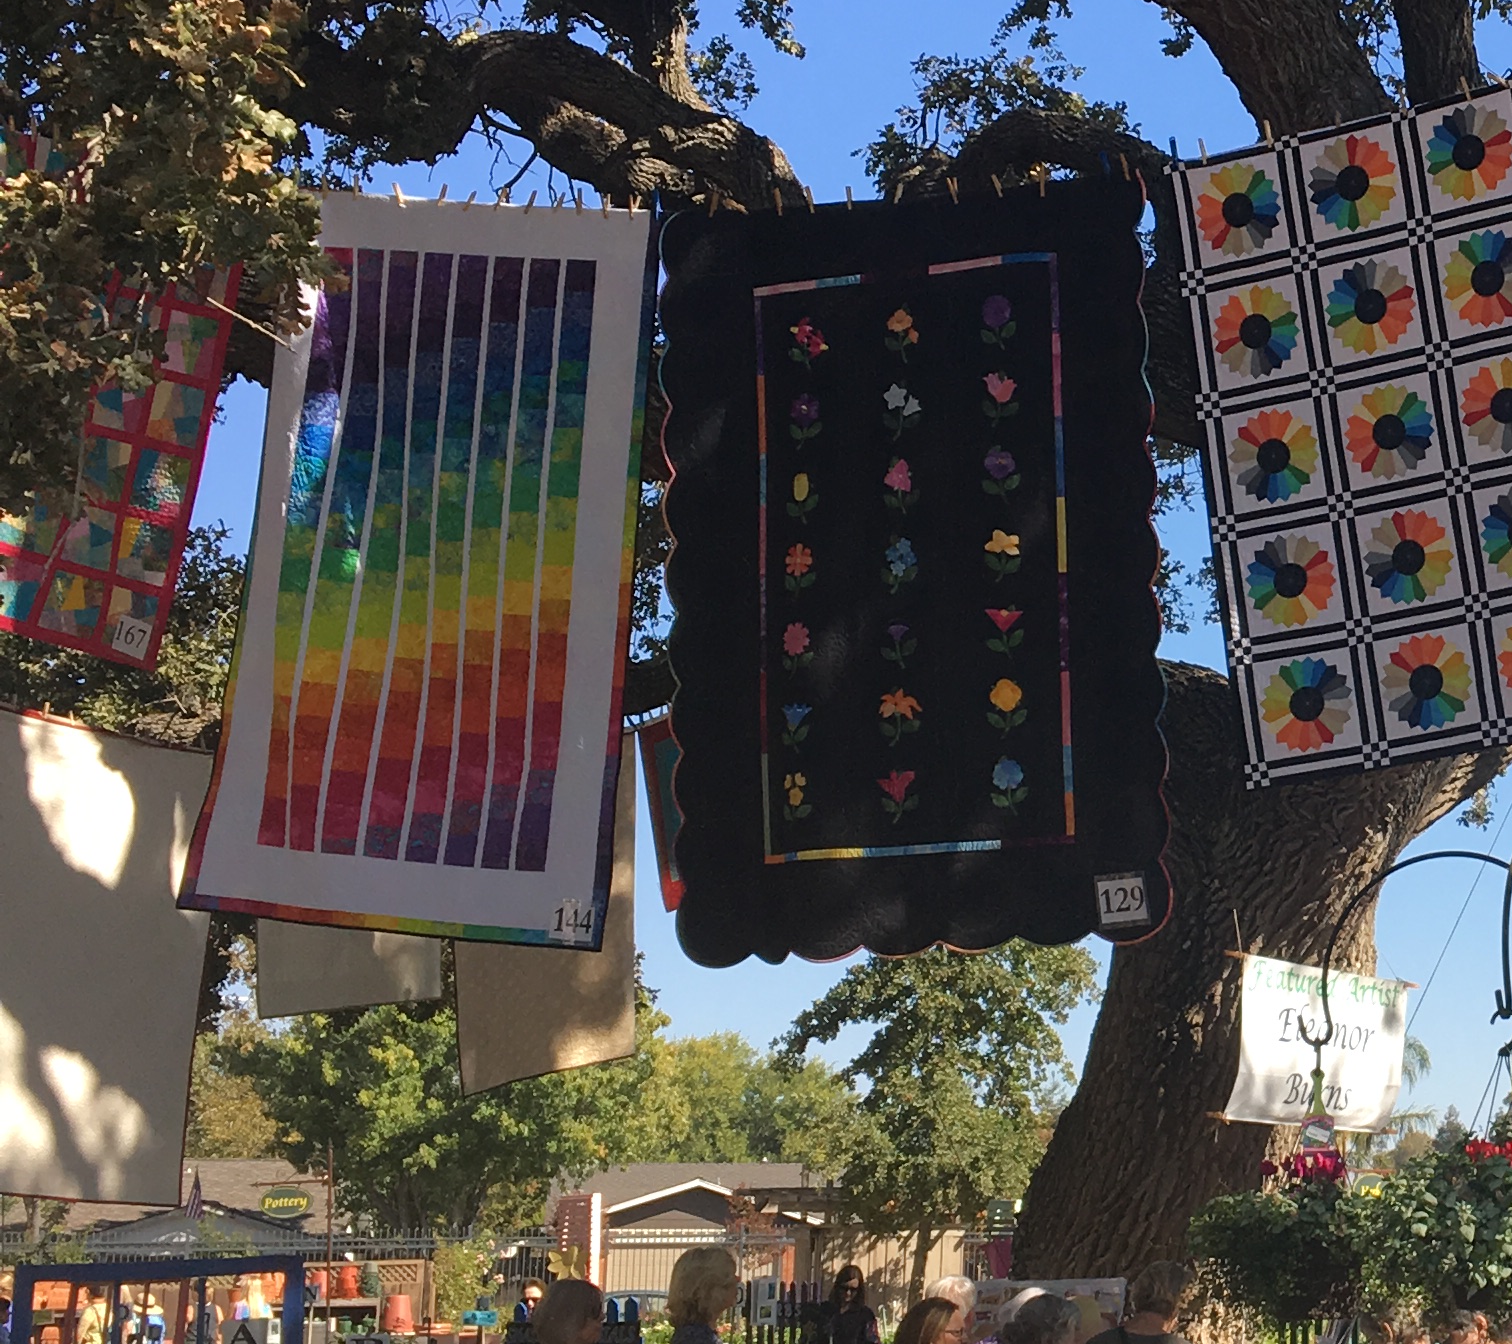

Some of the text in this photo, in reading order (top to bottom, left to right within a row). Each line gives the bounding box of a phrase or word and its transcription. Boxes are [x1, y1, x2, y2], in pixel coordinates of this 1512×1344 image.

[116, 620, 147, 648] 167
[1100, 885, 1144, 914] 129
[554, 907, 592, 934] 144
[1249, 960, 1400, 1008] Featured Artist
[1278, 1003, 1375, 1053] Eleanor
[264, 1197, 308, 1211] Pottery
